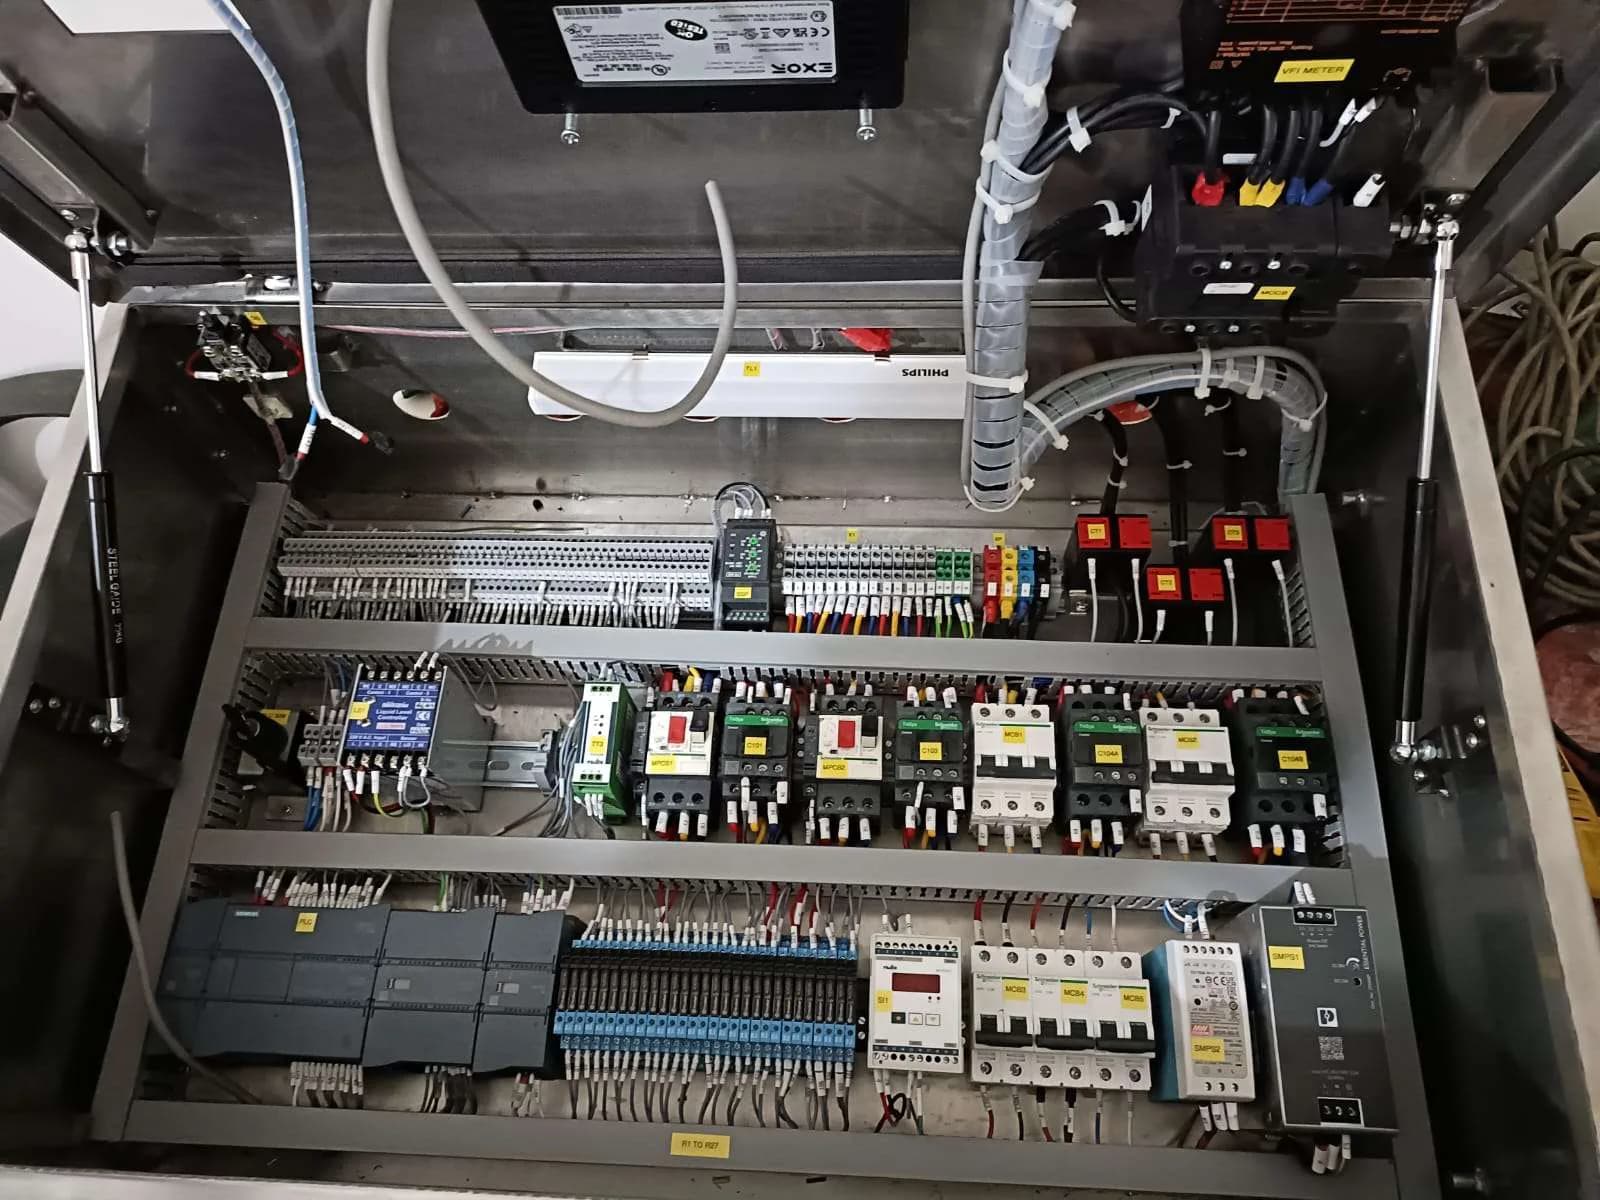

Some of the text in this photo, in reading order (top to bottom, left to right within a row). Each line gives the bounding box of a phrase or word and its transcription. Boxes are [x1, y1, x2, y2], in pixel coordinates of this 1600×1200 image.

[771, 63, 832, 74] EXOR
[1282, 66, 1345, 75] VFI METER
[901, 368, 949, 377] PHILIPS
[107, 547, 119, 581] STEEL
[299, 918, 312, 926] PLC
[1272, 952, 1299, 961] SMPS1
[1005, 985, 1026, 994] MCB3
[1063, 989, 1085, 997] MCB4
[1123, 994, 1145, 1003] MCB5
[1194, 1045, 1221, 1053] SMPS2
[693, 1140, 703, 1149] TO
